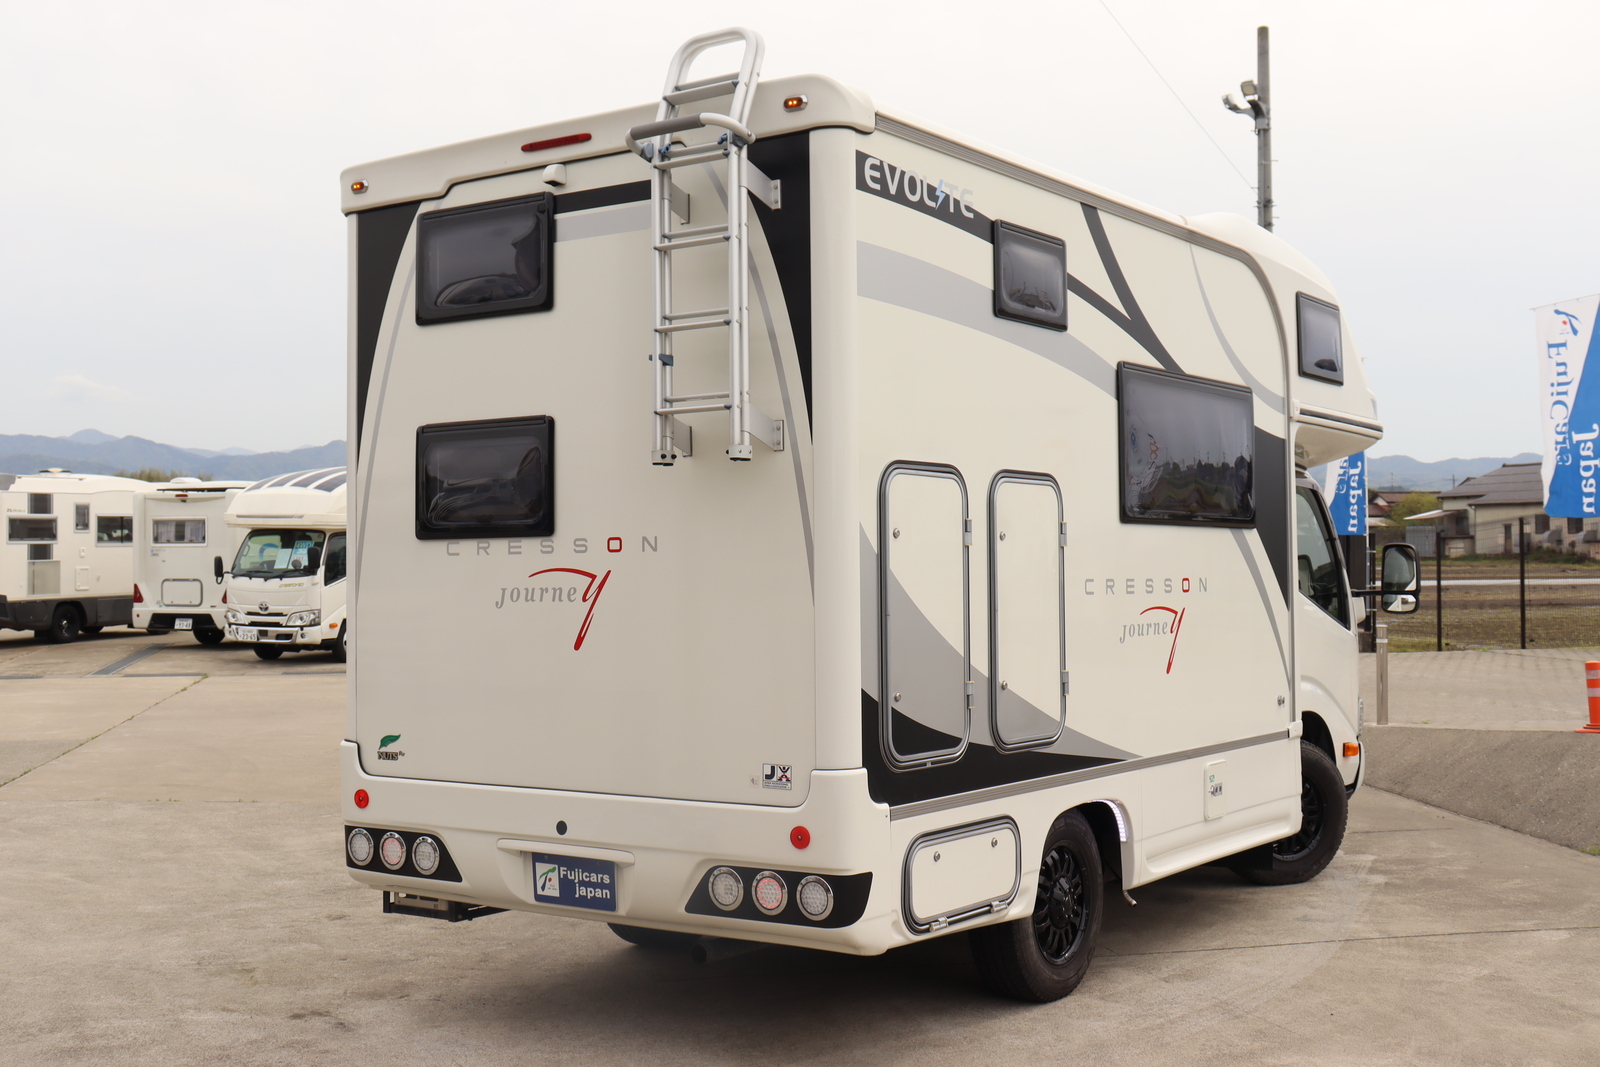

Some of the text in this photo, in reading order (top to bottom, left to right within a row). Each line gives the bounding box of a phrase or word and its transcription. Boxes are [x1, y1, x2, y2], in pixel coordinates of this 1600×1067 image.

[864, 157, 974, 219] EVOLITE
[446, 536, 659, 556] CRESSON
[1084, 577, 1208, 596] CRESSON
[376, 750, 399, 761] NUTS
[559, 866, 611, 884] Fujicars
[574, 883, 611, 900] japan
